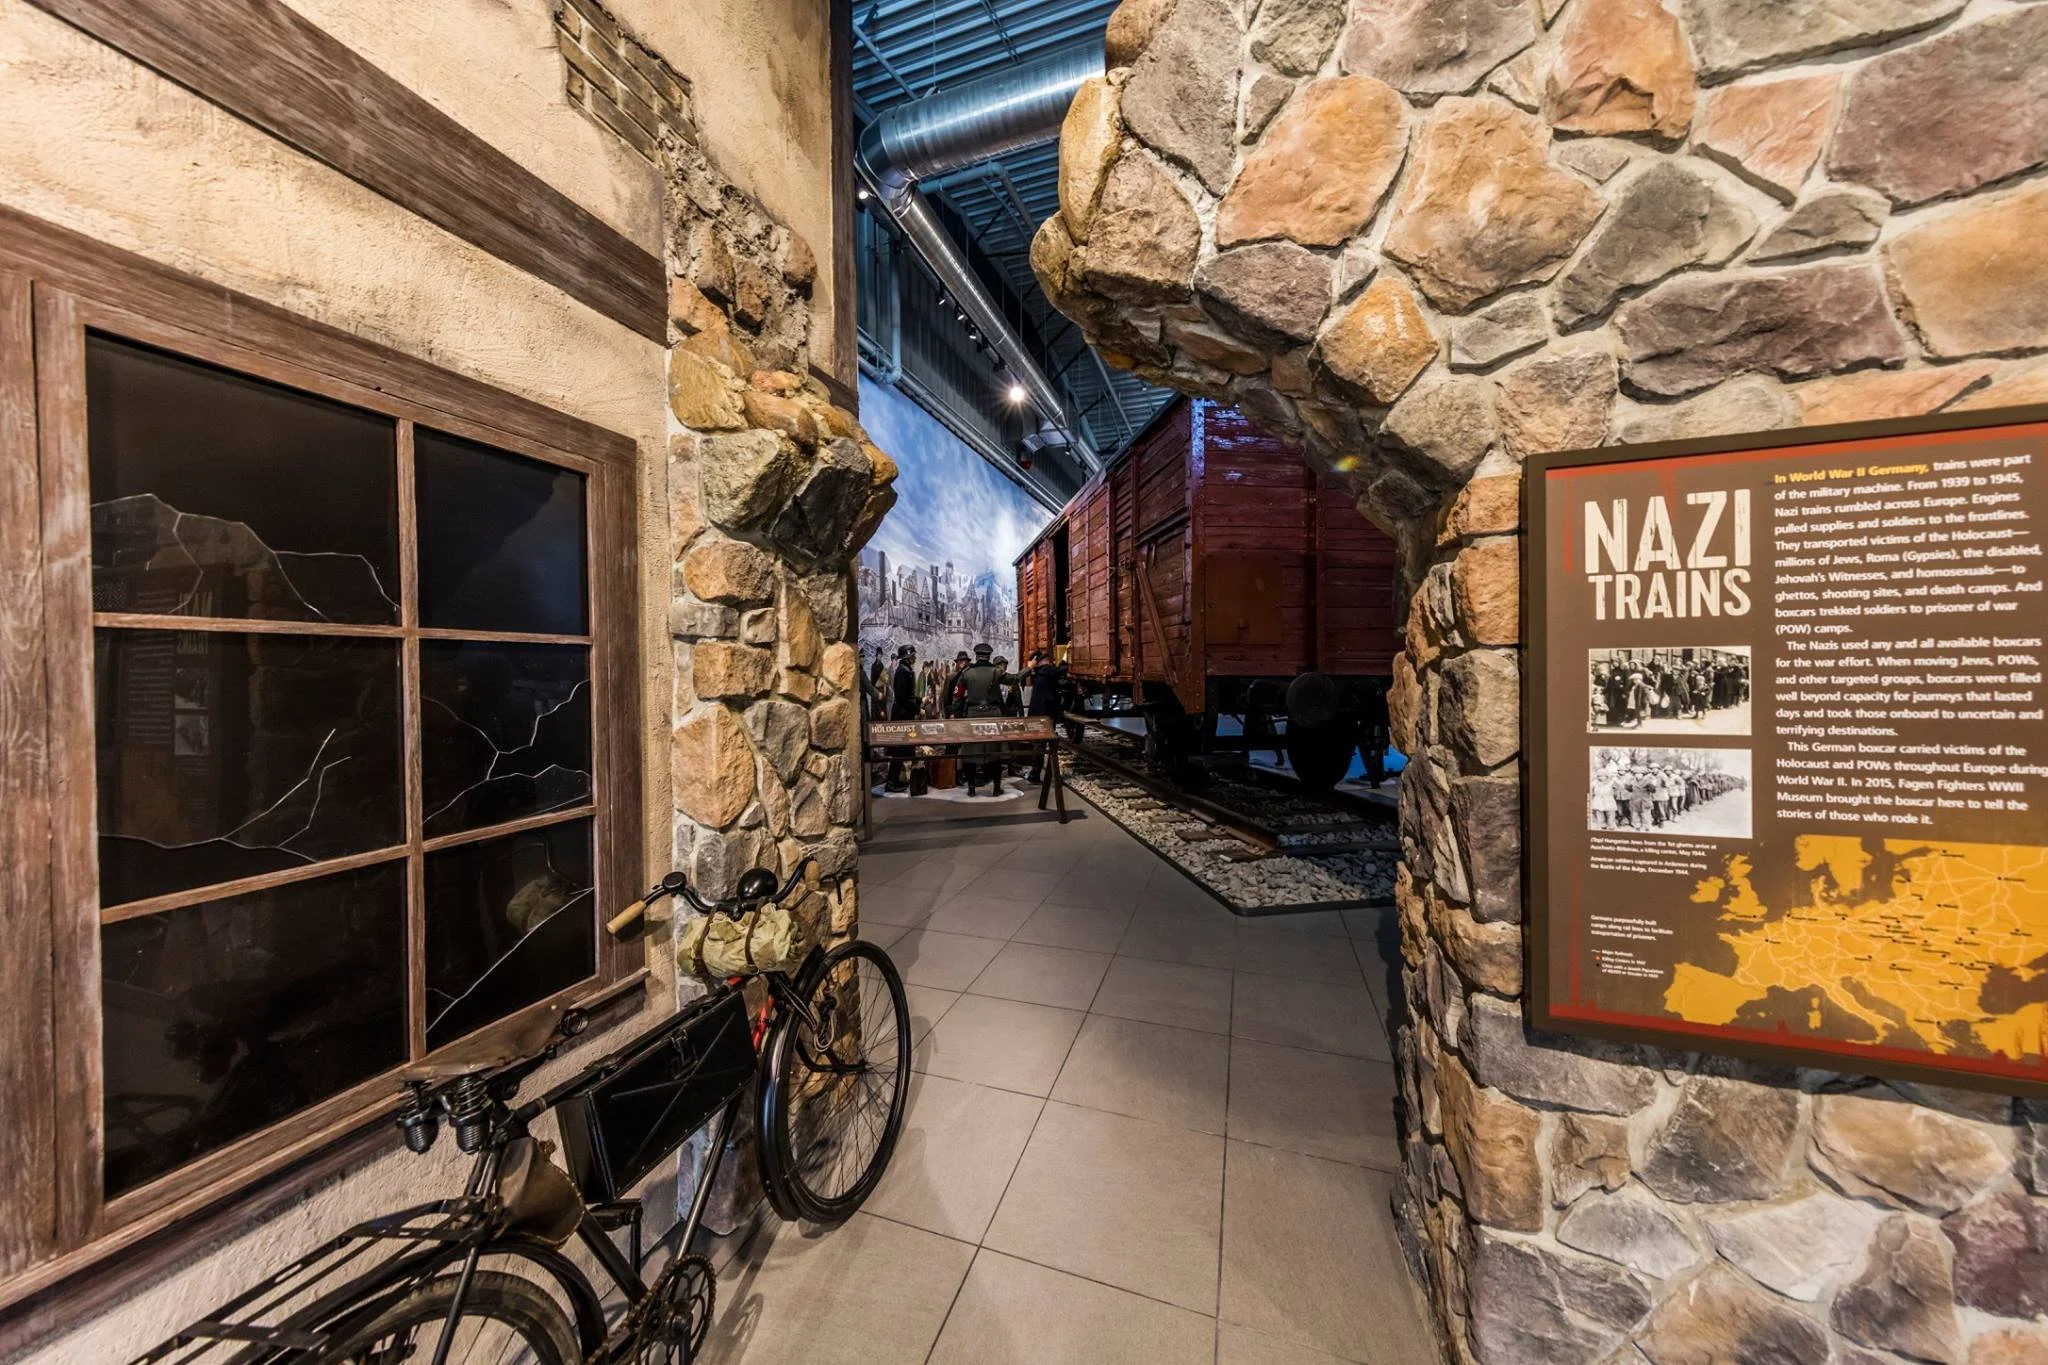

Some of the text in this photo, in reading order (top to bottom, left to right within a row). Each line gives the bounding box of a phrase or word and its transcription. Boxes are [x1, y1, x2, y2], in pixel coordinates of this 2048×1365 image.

[1774, 454, 2031, 483] In World War II Germany, trains were part
[1774, 472, 2024, 500] of the military machine. From 1939 to 1945,
[1774, 492, 2020, 517] Nazi trains rumbled across Europe. Engines
[1774, 509, 2029, 536] pulled supplies and soldiers to the frontlines.
[1585, 489, 1750, 574] NAZI
[1774, 540, 1800, 552] They
[1803, 535, 1867, 549] transported
[1869, 534, 1911, 545] victims
[1912, 532, 1926, 543] of
[1928, 531, 1949, 542] the
[1774, 544, 2042, 567] millions of Jews, Roma (Gypsies), the disabled,
[1775, 572, 1826, 584] Jehovah's
[1828, 571, 1888, 581] Witnesses,
[1890, 568, 1914, 579] and
[1588, 568, 1751, 620] TRAINS
[1774, 580, 2042, 603] ghettos, shooting sites, and death camps. And
[1775, 600, 2018, 617] boxcars trekked soldiers to prisoner of war
[1775, 623, 1853, 635] (POW) camps.
[1786, 636, 2042, 651] The Nazis used any and all available boxcars
[1775, 657, 1791, 667] for
[1793, 657, 1812, 667] the
[1838, 656, 1873, 667] effort.
[1876, 656, 1911, 666] When
[1913, 655, 1958, 668] moving
[1960, 655, 1994, 666] Jews,
[1997, 654, 2039, 665] POWs,
[1775, 672, 2042, 686] and other targeted groups, boxcars were filled
[1775, 690, 2032, 703] well beyond capacity for journeys that lasted
[1775, 707, 2043, 720] days and took those onboard to uncertain and
[872, 725, 916, 733] HOLOCAUST
[1776, 724, 1898, 737] terrifying destinations.
[1787, 741, 2027, 756] This German boxcar carried victims of the
[1776, 758, 1829, 768] Holocaust
[1832, 759, 1854, 769] and
[1856, 760, 1891, 770] POWs
[1893, 760, 1960, 774] throughout
[1963, 762, 2006, 775] Europe
[1776, 775, 2024, 792] World War II. In 2015, Fagen Fighters WWII
[1776, 791, 2028, 810] Museum brought the boxcar here to tell the
[1776, 808, 1933, 824] stories of those who rode it.
